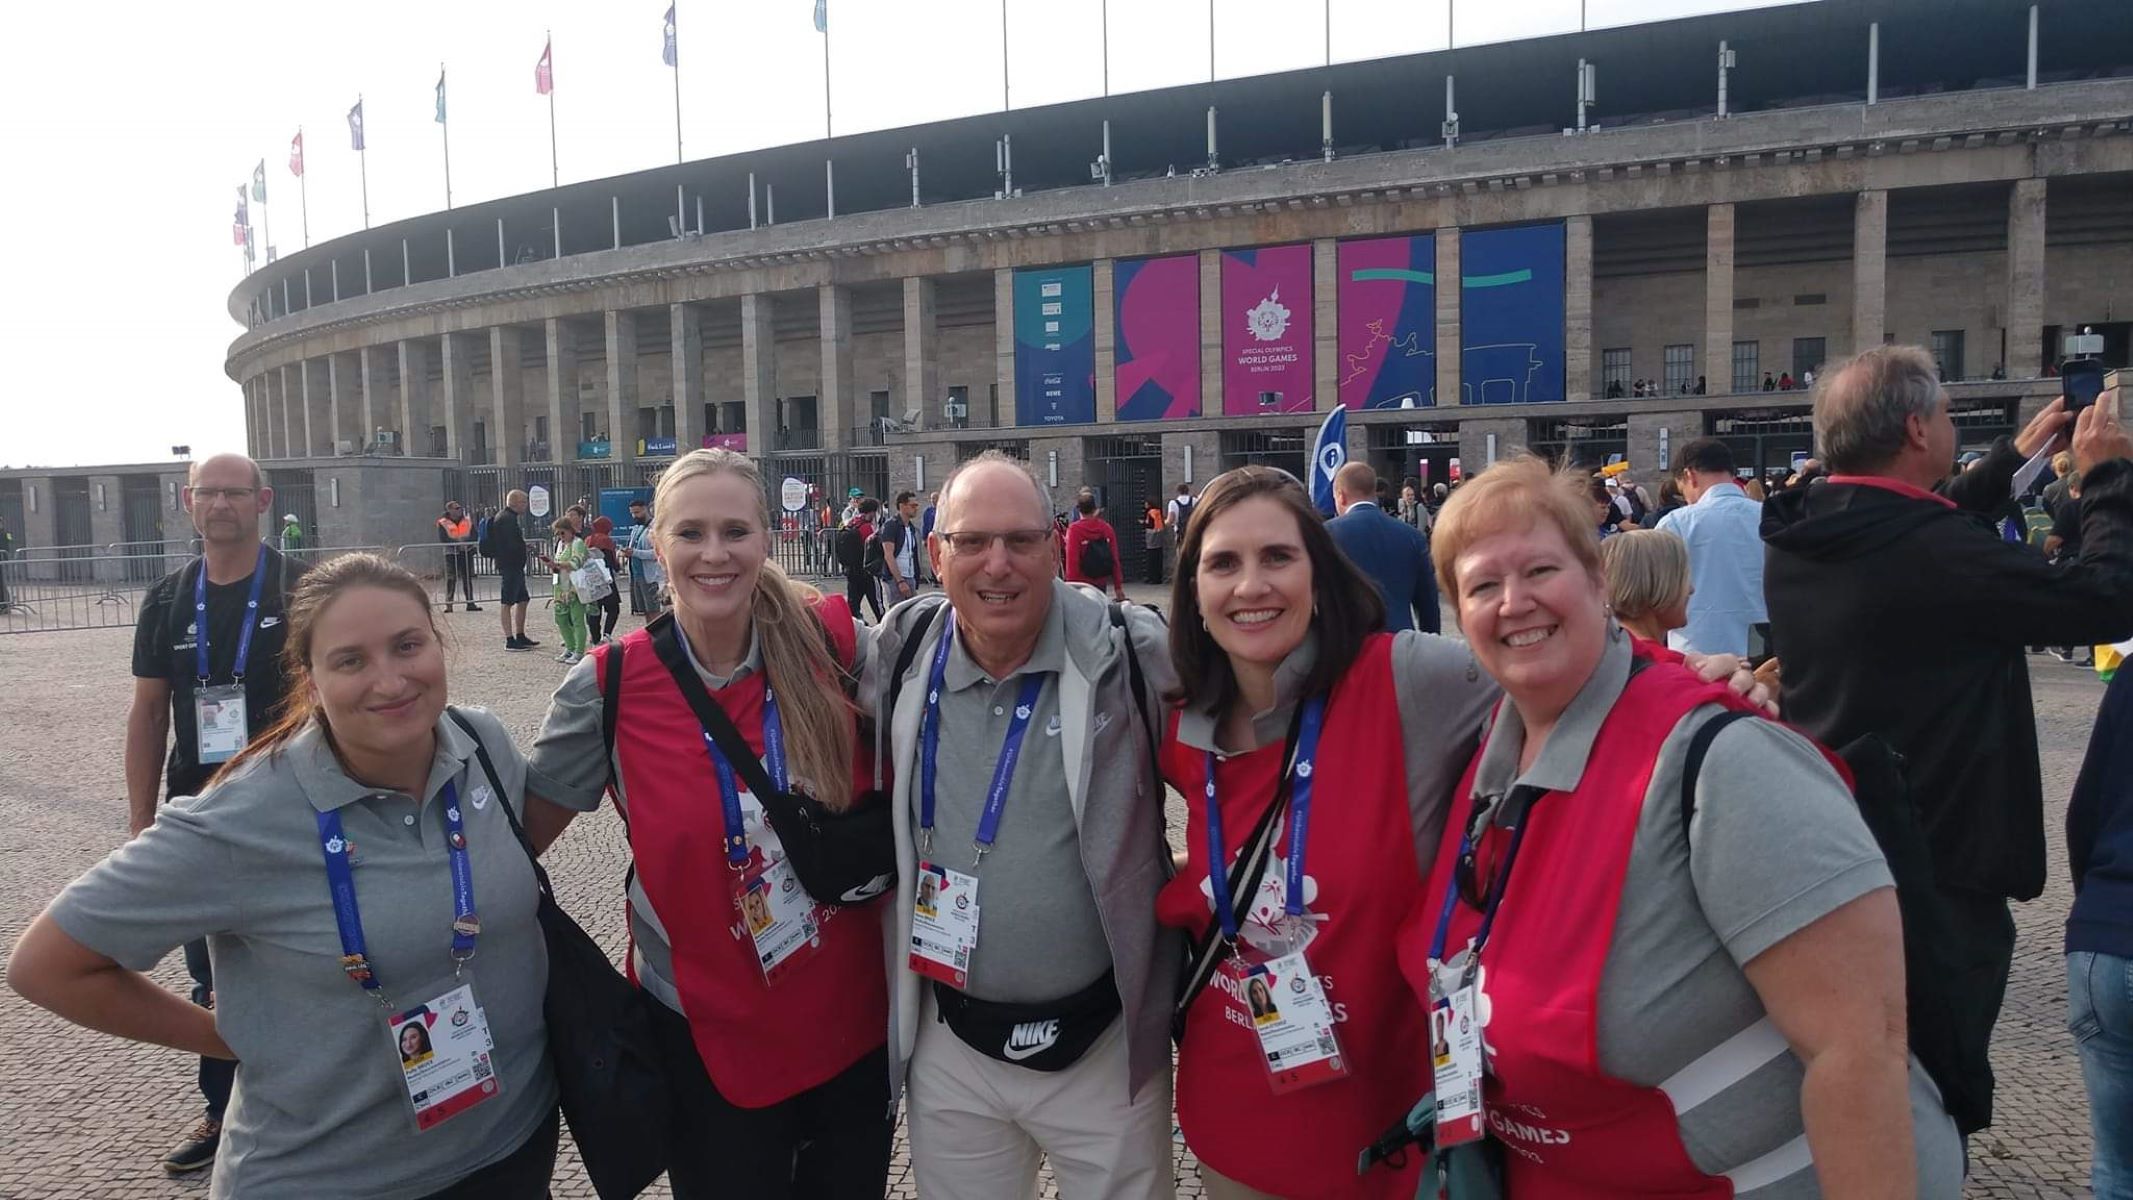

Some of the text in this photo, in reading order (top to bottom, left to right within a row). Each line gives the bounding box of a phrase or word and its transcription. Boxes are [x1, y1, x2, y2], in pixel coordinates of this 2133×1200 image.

[1238, 354, 1298, 364] WORLD GAMES
[1209, 970, 1248, 1005] WORL
[1225, 1005, 1254, 1030] BERL
[1010, 1018, 1060, 1047] NIKE
